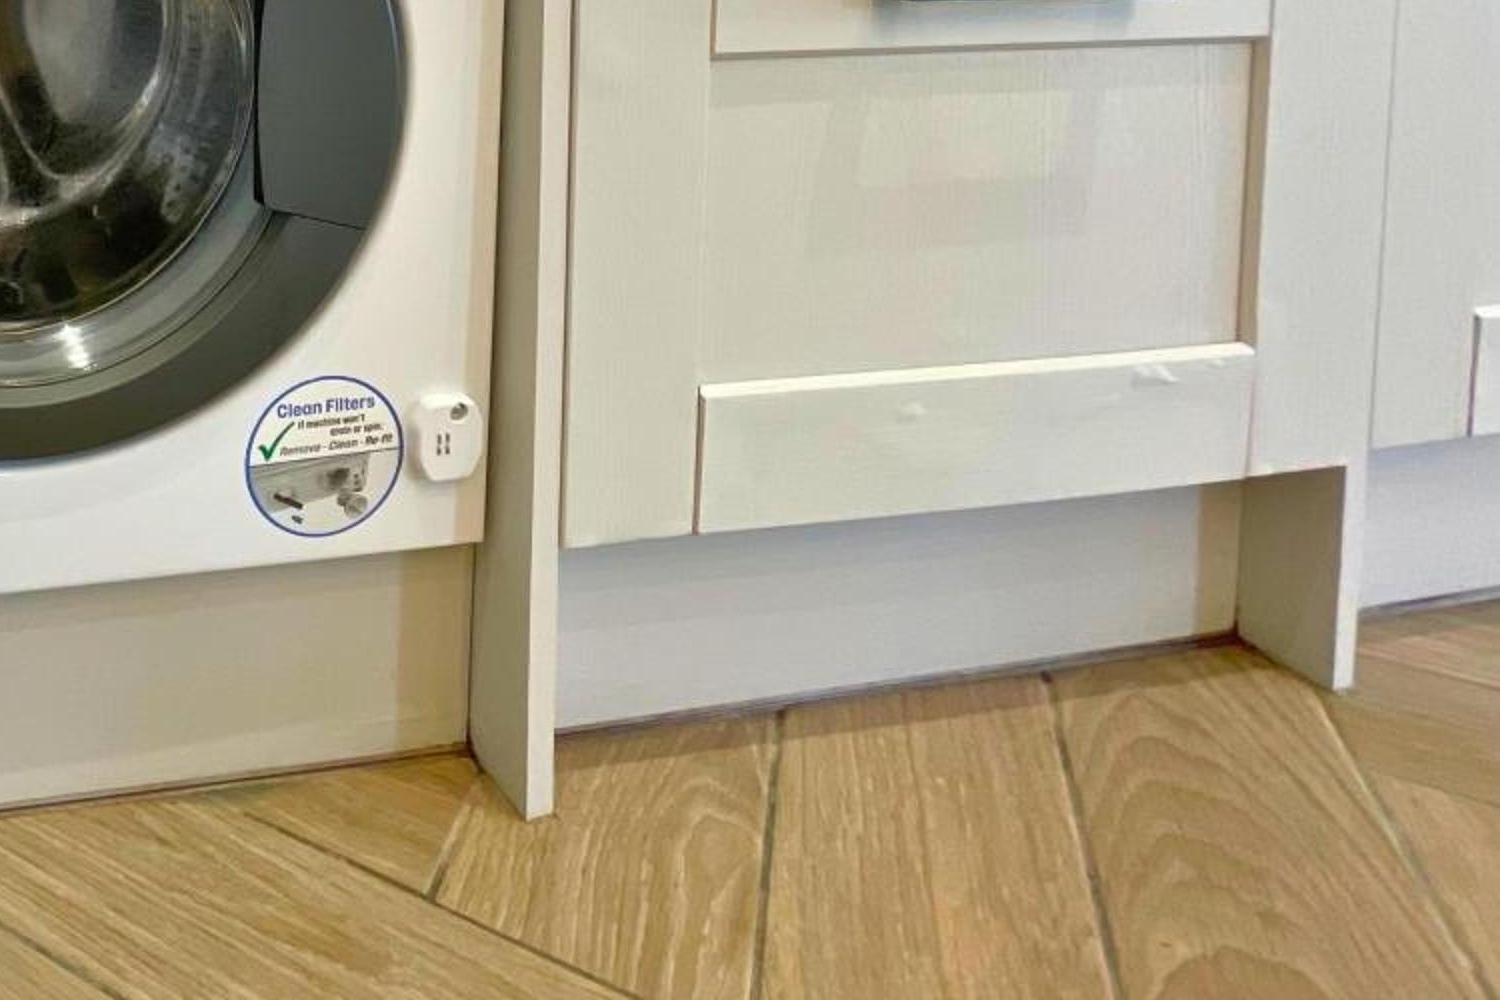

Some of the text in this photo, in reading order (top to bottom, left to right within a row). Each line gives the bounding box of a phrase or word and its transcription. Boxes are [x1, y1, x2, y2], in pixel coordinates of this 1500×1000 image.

[277, 396, 376, 418] Clean Filters
[328, 439, 359, 451] Clean
